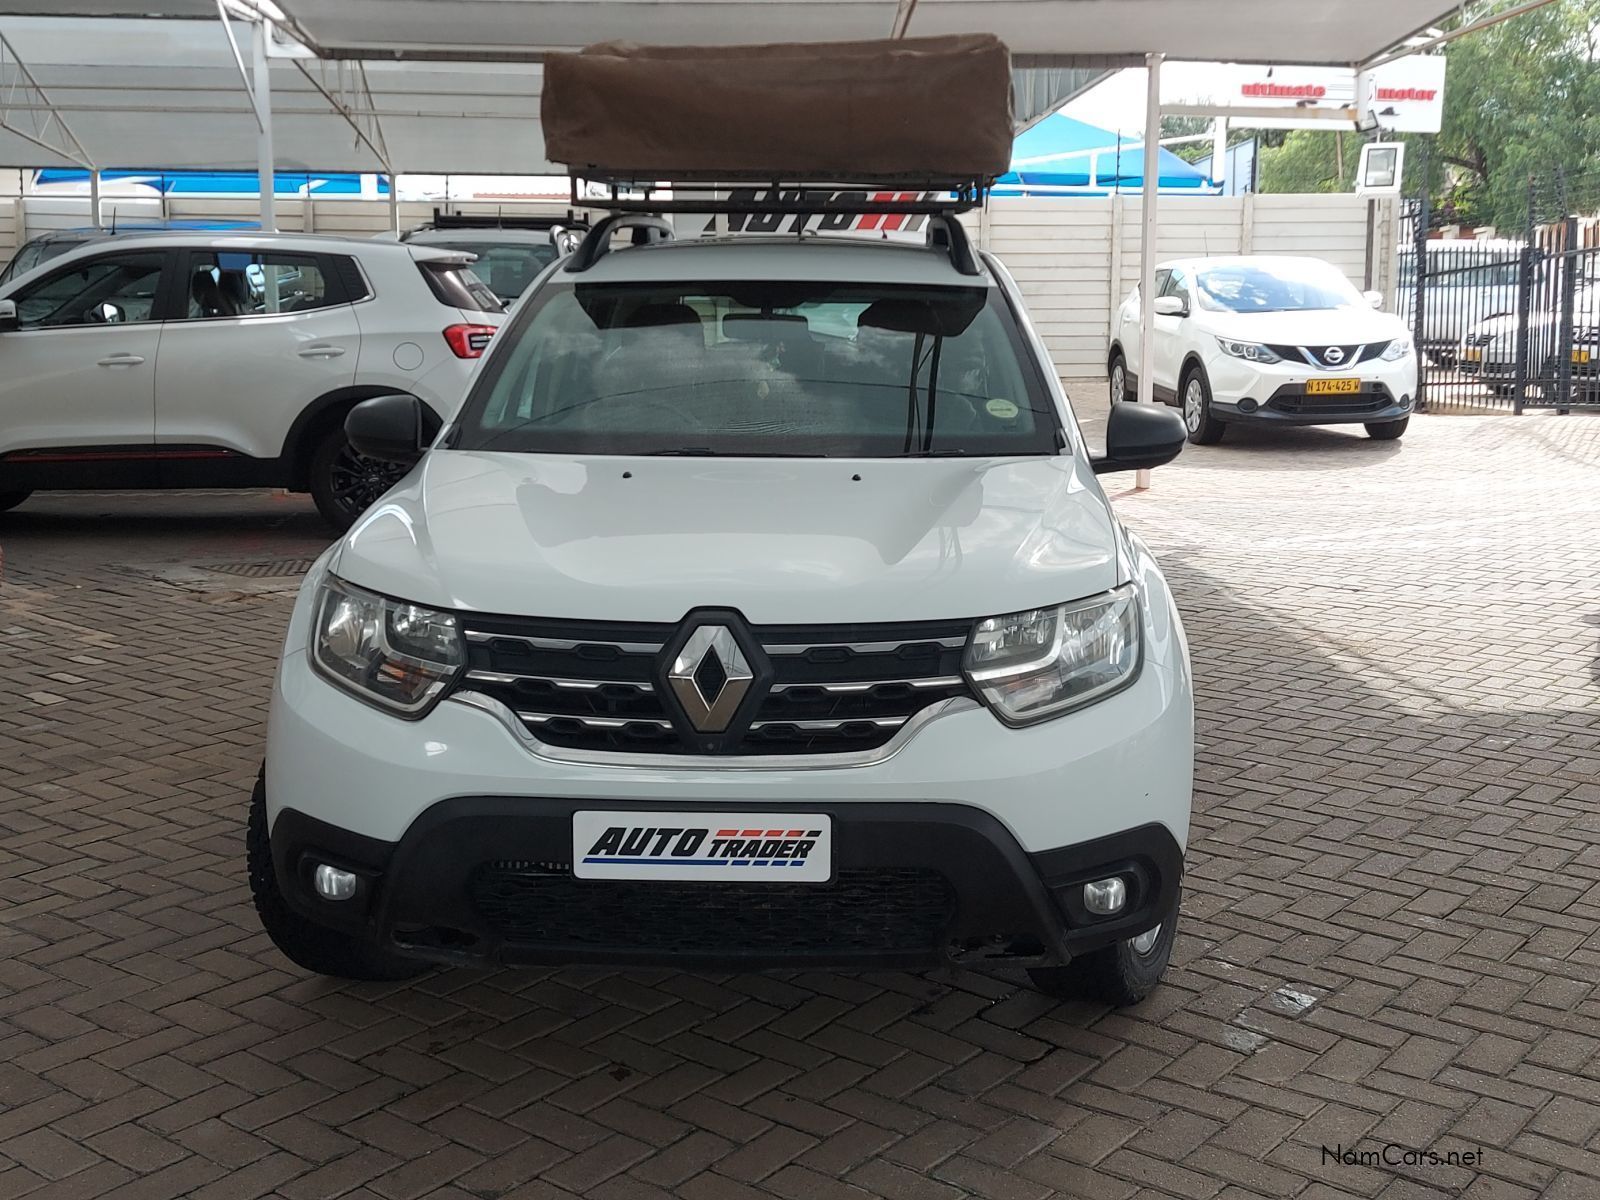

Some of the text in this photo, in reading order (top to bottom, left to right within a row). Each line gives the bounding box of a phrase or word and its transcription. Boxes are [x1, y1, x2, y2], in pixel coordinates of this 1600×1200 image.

[1241, 83, 1437, 101] ultimate motor
[1307, 382, 1313, 392] N
[1354, 381, 1360, 391] W
[587, 827, 816, 858] AUTO TRADER
